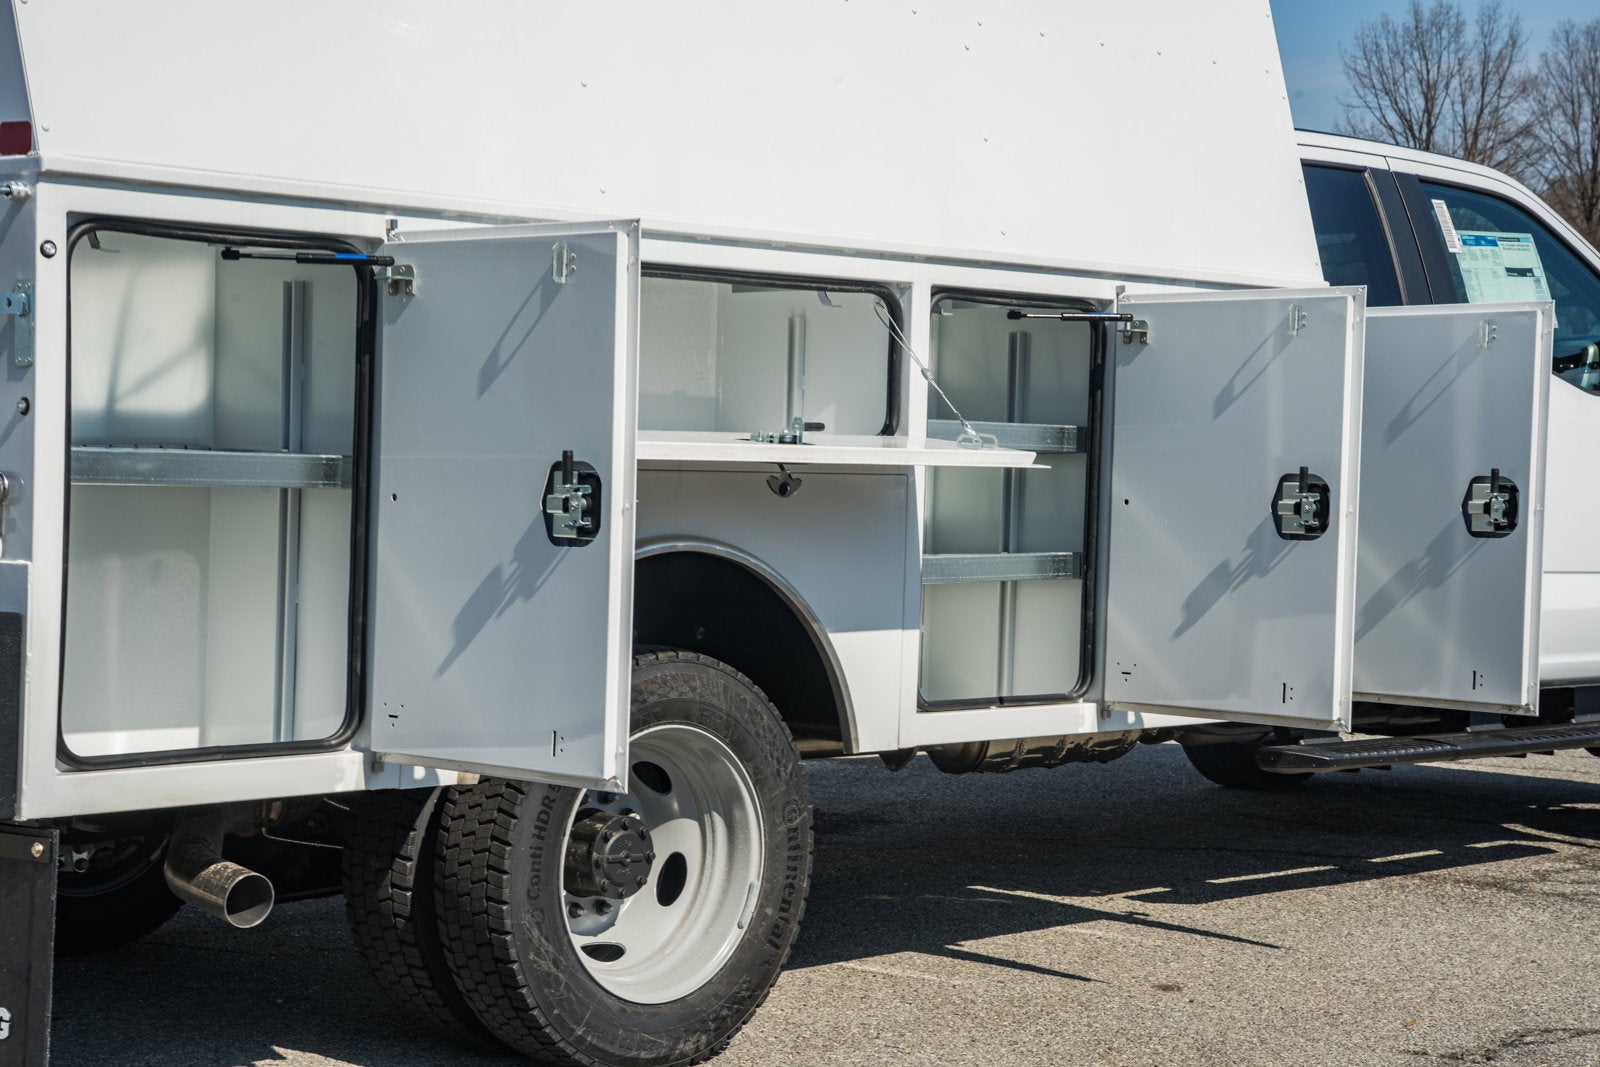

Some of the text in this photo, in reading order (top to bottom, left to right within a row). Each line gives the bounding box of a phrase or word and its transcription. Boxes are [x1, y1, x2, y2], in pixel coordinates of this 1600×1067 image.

[532, 795, 556, 841] HDR
[526, 846, 543, 900] Conti
[767, 799, 802, 950] Continental
